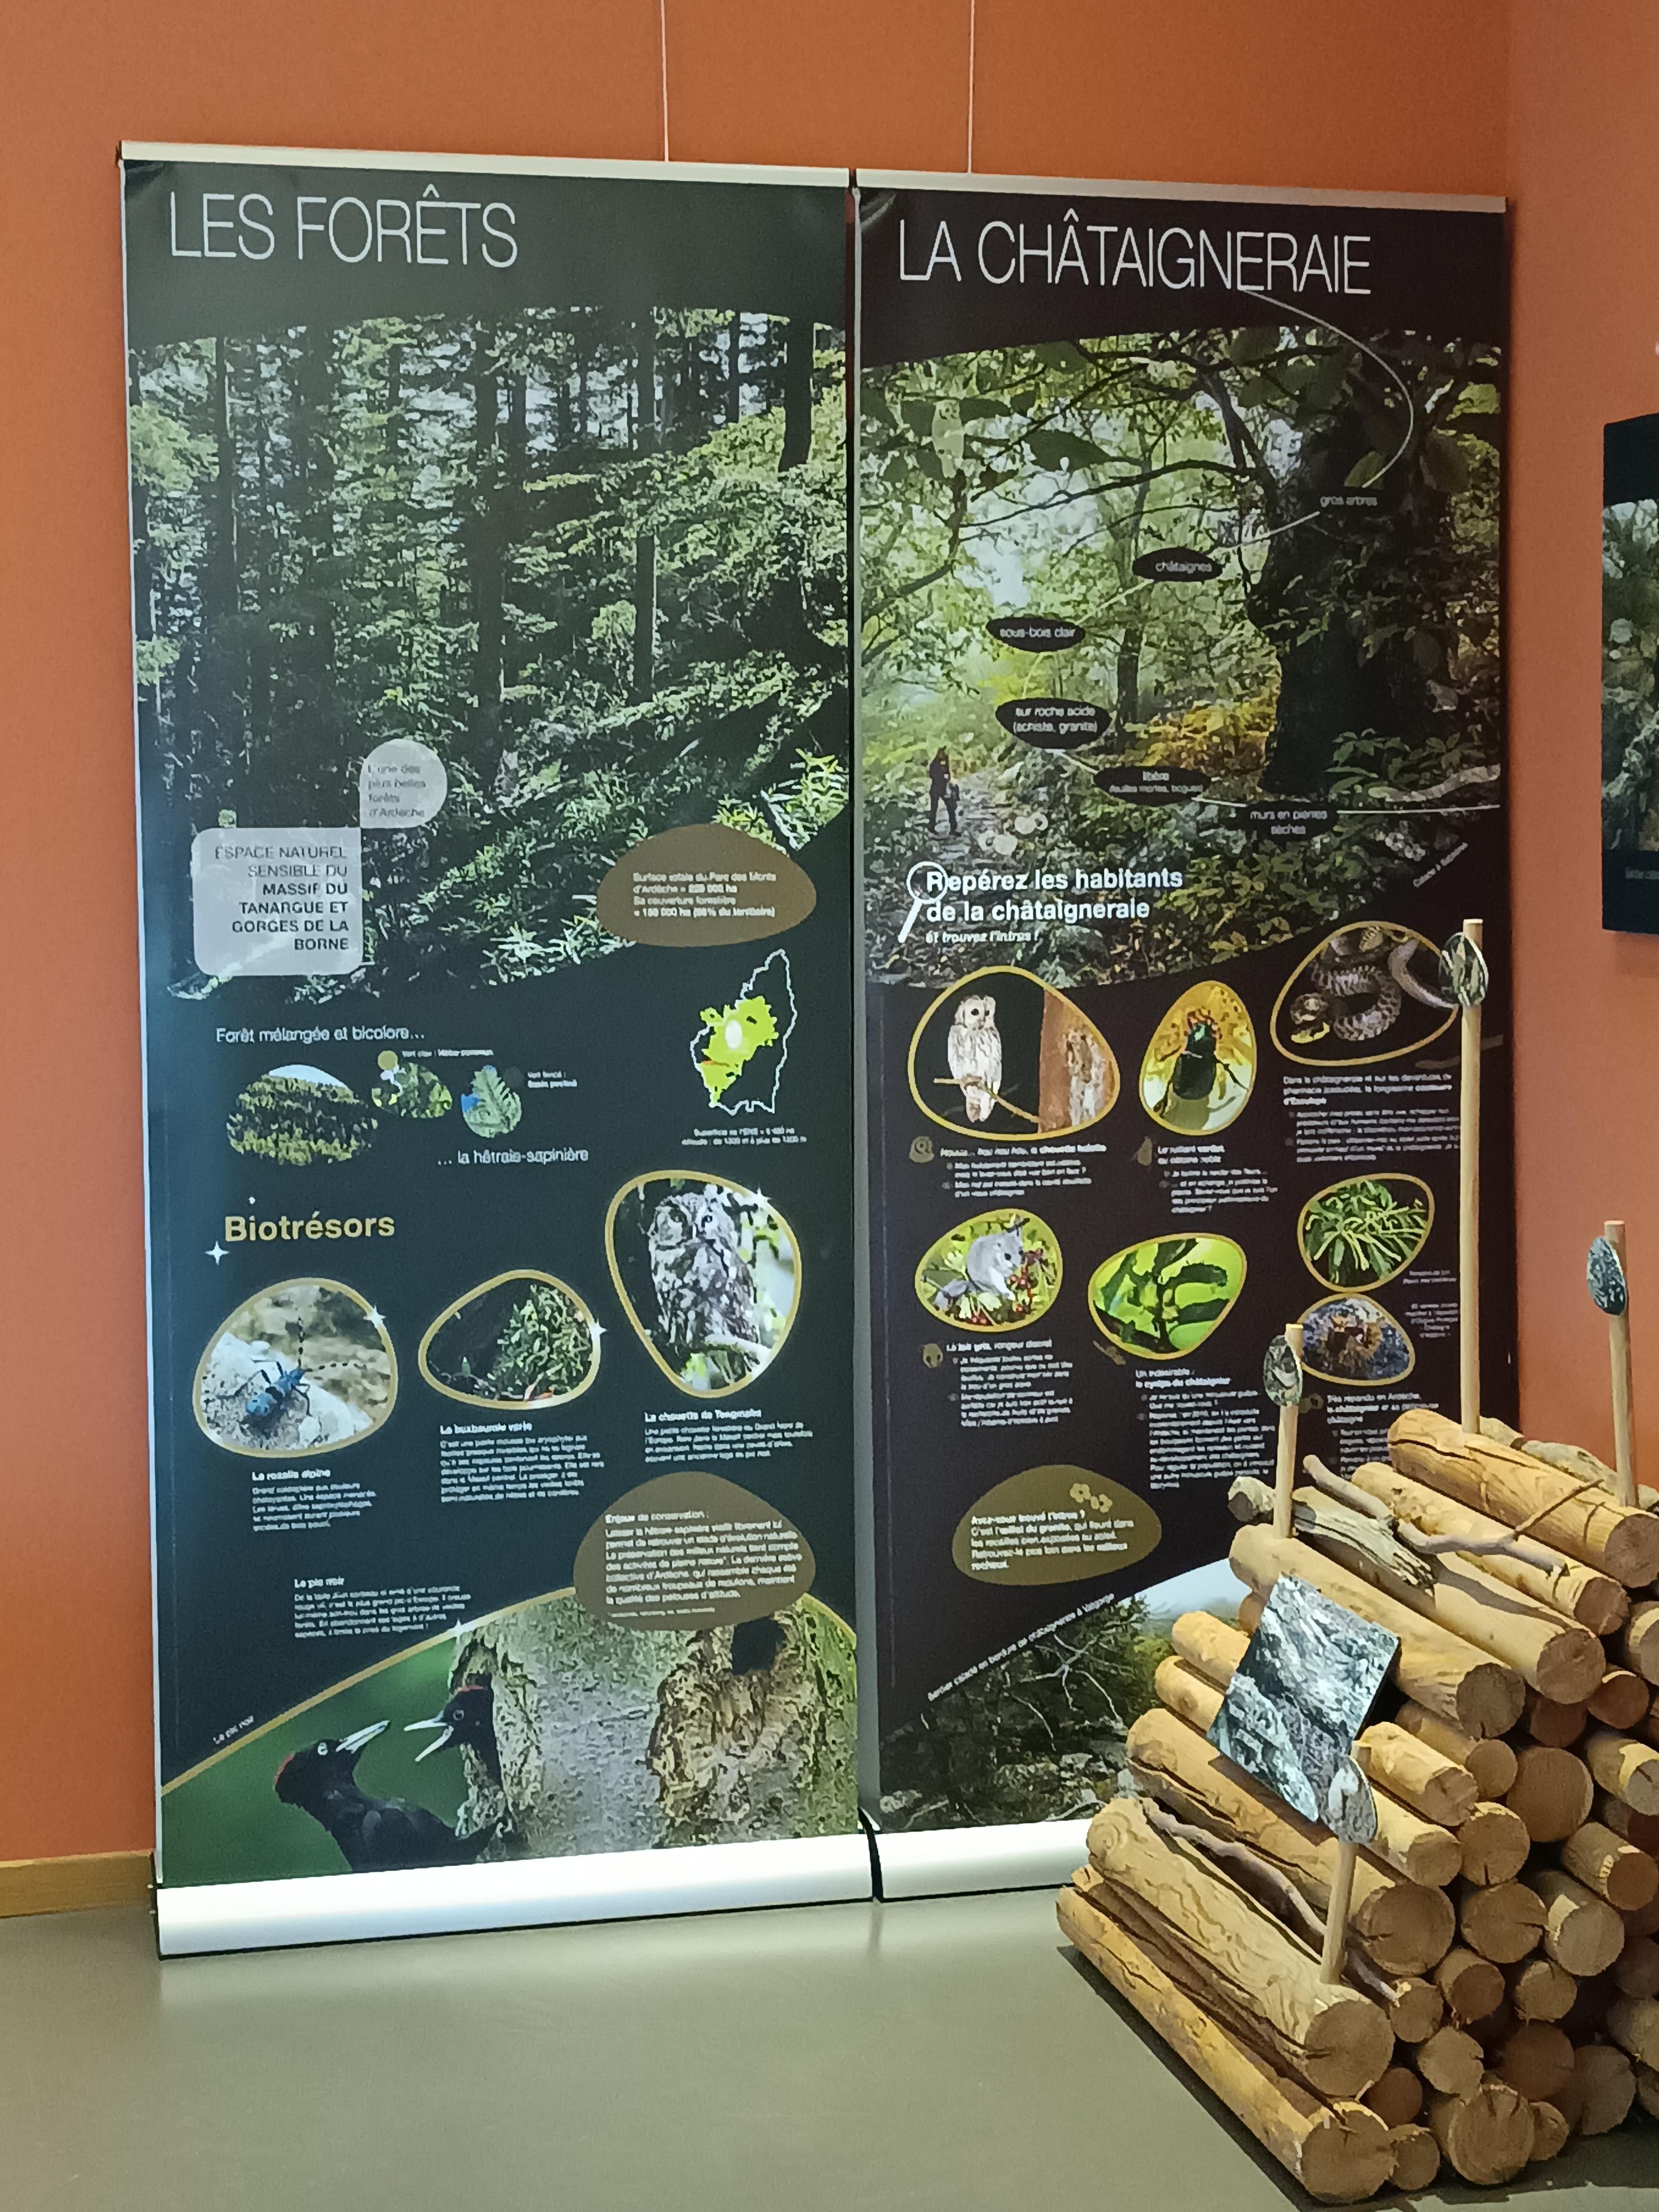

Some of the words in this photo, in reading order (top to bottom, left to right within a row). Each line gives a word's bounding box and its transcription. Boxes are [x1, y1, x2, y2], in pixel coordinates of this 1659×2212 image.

[171, 191, 275, 259] LES
[296, 184, 518, 268] FORÊTS
[900, 218, 962, 282] LA
[977, 207, 1371, 295] CHÂTAIGNERAIE
[1000, 624, 1051, 638] sous-bois
[1055, 626, 1076, 638] clair
[1034, 706, 1065, 717] roche
[1277, 810, 1291, 820] en
[215, 845, 274, 860] ESPACE
[279, 846, 347, 860] NATUREL
[247, 864, 321, 878] SENSIBLE
[326, 864, 347, 878] DU
[926, 869, 1028, 895] Repérez
[1034, 868, 1068, 890] les
[1074, 867, 1183, 889] habitants
[263, 883, 321, 896] MASSIF
[325, 883, 348, 895] DU
[239, 901, 324, 914] TANARGUE
[330, 901, 348, 914] ET
[926, 901, 956, 922] de
[964, 900, 984, 922] la
[990, 897, 1150, 924] châtaigneraie
[232, 920, 299, 933] GORGES
[304, 920, 324, 932] DE
[330, 920, 349, 932] LA
[942, 931, 988, 943] trouvez
[294, 938, 349, 951] BORNE
[216, 1027, 255, 1044] Forêt
[259, 1024, 330, 1045] mélangée
[333, 1026, 349, 1041] et
[457, 1150, 470, 1165] la
[473, 1147, 589, 1165] hêtraie-sapinière
[225, 1211, 395, 1242] Biotrésors
